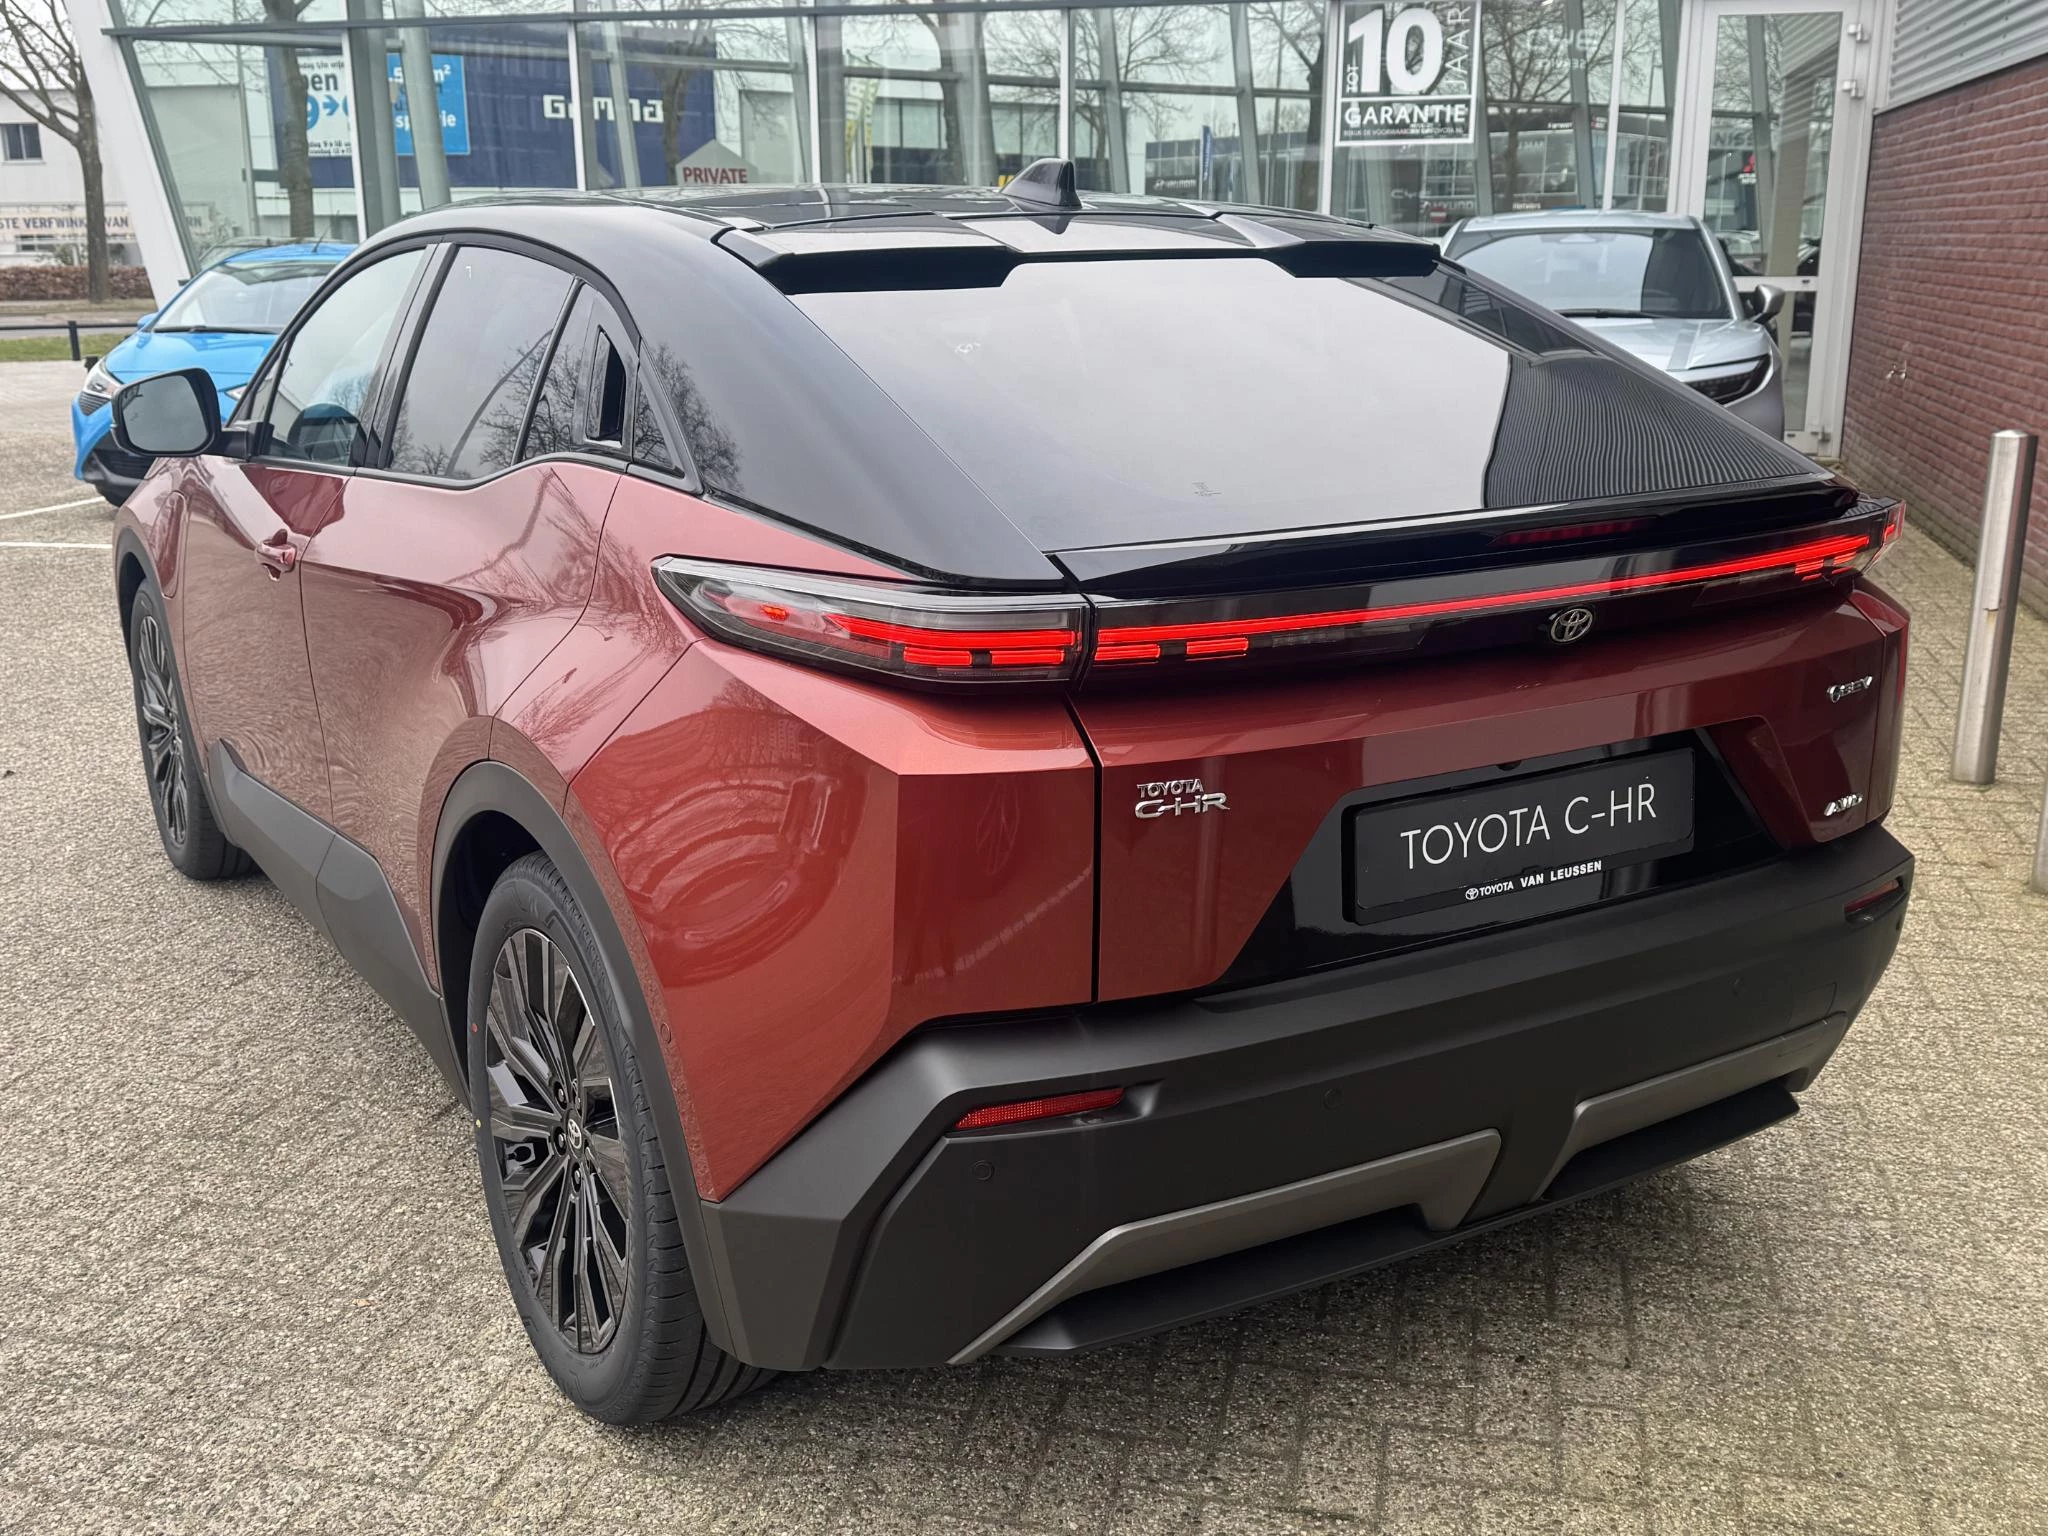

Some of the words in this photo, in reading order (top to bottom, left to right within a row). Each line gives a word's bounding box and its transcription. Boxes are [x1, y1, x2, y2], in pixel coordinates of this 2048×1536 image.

[1348, 8, 1443, 94] 10
[1444, 6, 1471, 91] JAAR
[1344, 104, 1466, 127] GARANTIE
[683, 167, 749, 184] PRIVATE
[23, 217, 89, 228] VERFWINK
[1136, 779, 1204, 798] TOYOTA
[1400, 805, 1550, 870] TOYOTA
[1564, 783, 1657, 835] C-HR
[1479, 882, 1514, 897] TOYOTA
[1520, 873, 1544, 888] VAN
[1550, 860, 1602, 881] LEUSSEN
